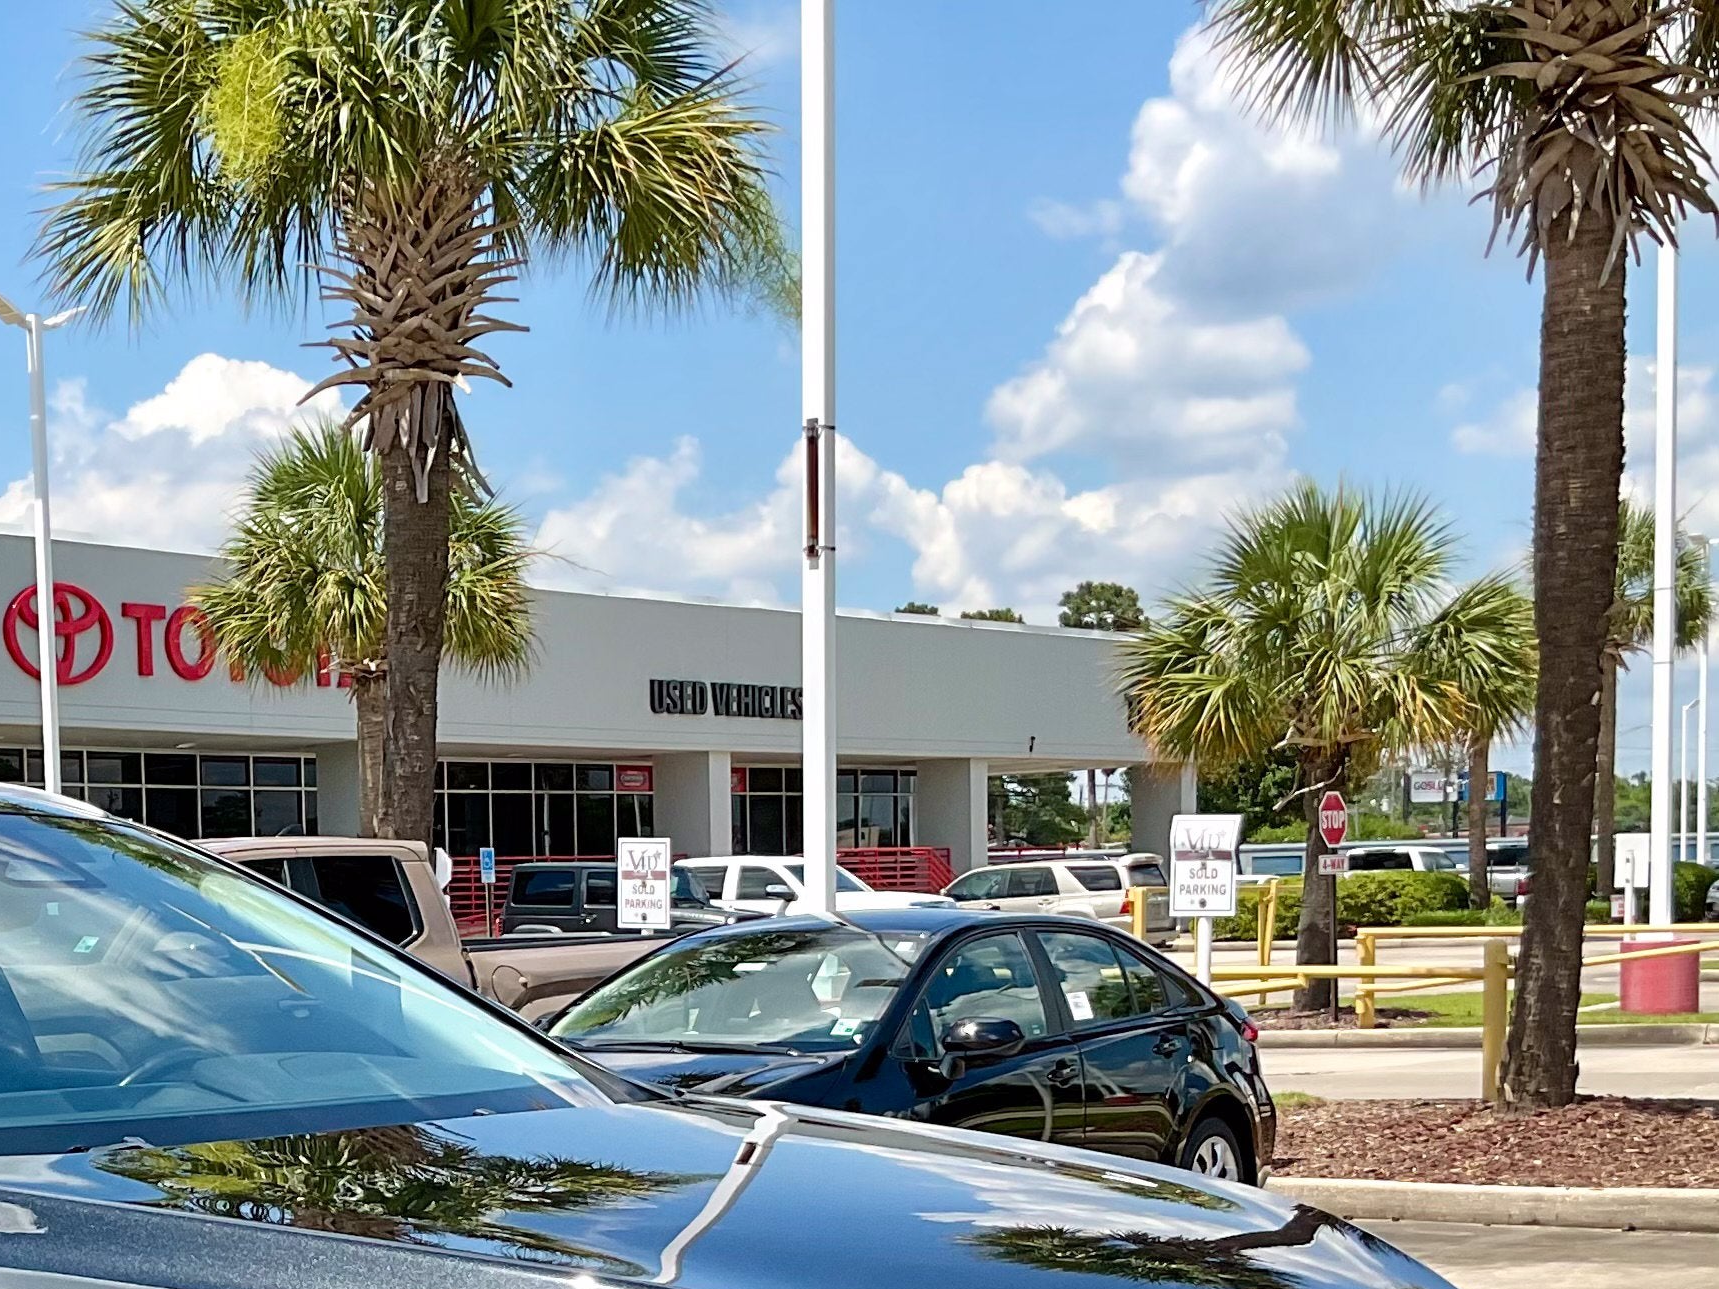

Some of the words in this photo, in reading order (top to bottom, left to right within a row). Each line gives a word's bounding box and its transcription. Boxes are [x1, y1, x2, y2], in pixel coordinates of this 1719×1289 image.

[649, 679, 708, 715] USED
[710, 682, 804, 720] VEHICLES
[1321, 810, 1346, 830] STOP
[1322, 857, 1345, 870] 4-WAY
[1189, 868, 1218, 880] SOLD
[632, 884, 655, 895] SOLD
[1179, 883, 1227, 896] PARKING
[624, 898, 663, 909] PARKING
